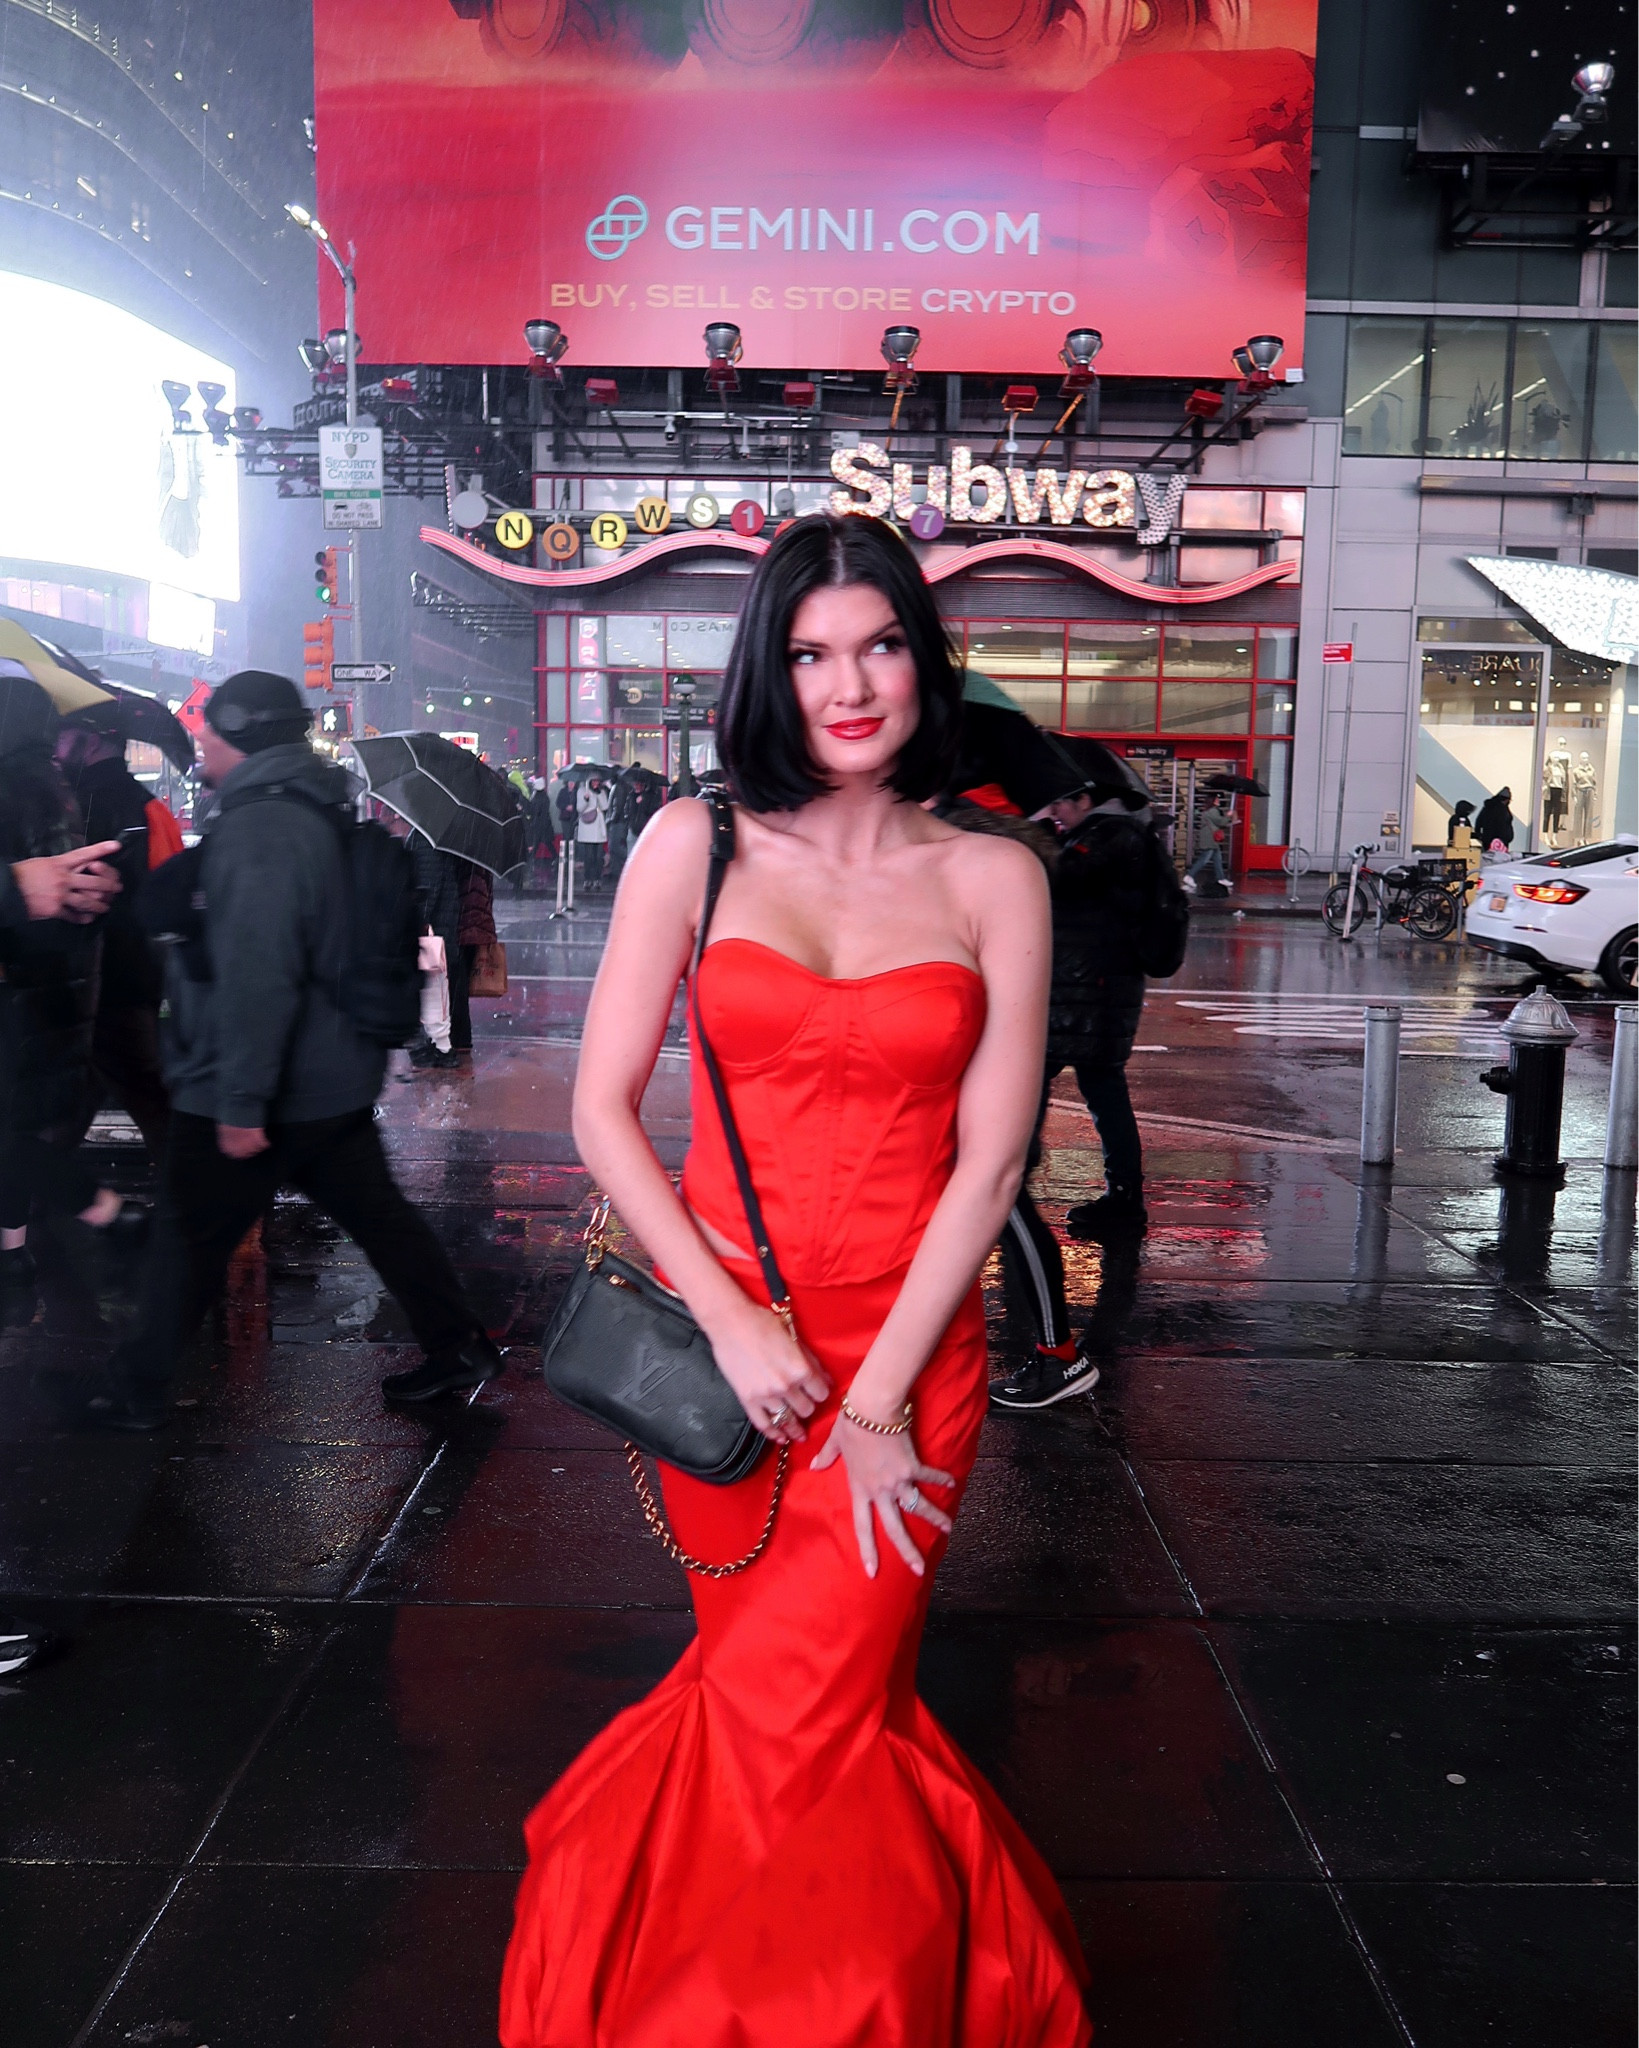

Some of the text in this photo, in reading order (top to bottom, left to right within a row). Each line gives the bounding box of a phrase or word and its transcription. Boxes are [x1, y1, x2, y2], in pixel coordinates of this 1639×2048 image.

[665, 205, 1040, 256] GEMINI.COM
[550, 283, 1077, 316] BUY, SELL & STORE CRYPTO
[331, 432, 370, 443] NYPD
[828, 441, 1190, 546] Subway
[504, 498, 937, 553] N Q R W S 1 7
[336, 669, 383, 677] ONE WAY
[1063, 1356, 1090, 1380] HOKA
